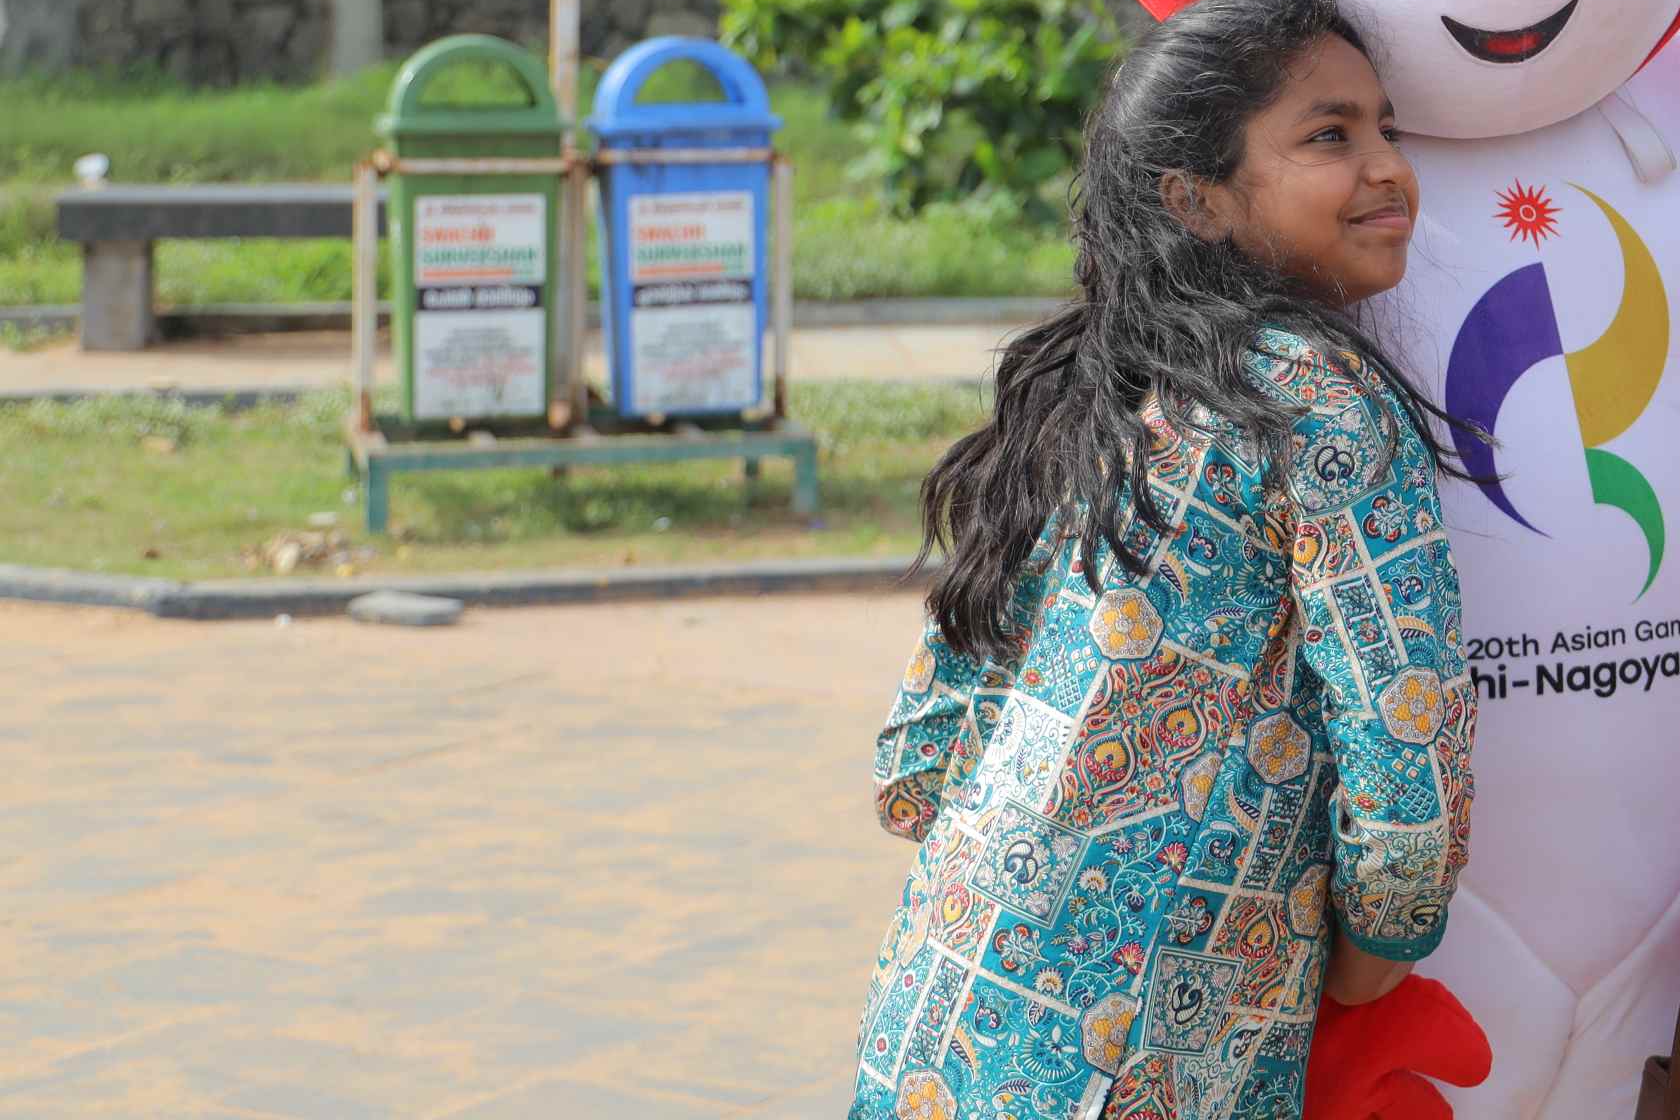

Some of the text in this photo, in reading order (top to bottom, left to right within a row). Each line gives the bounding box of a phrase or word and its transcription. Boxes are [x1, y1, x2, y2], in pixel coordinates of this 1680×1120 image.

[1467, 633, 1539, 660] 20th
[1550, 625, 1626, 655] Asian
[1470, 651, 1680, 699] hi-Nagoya
